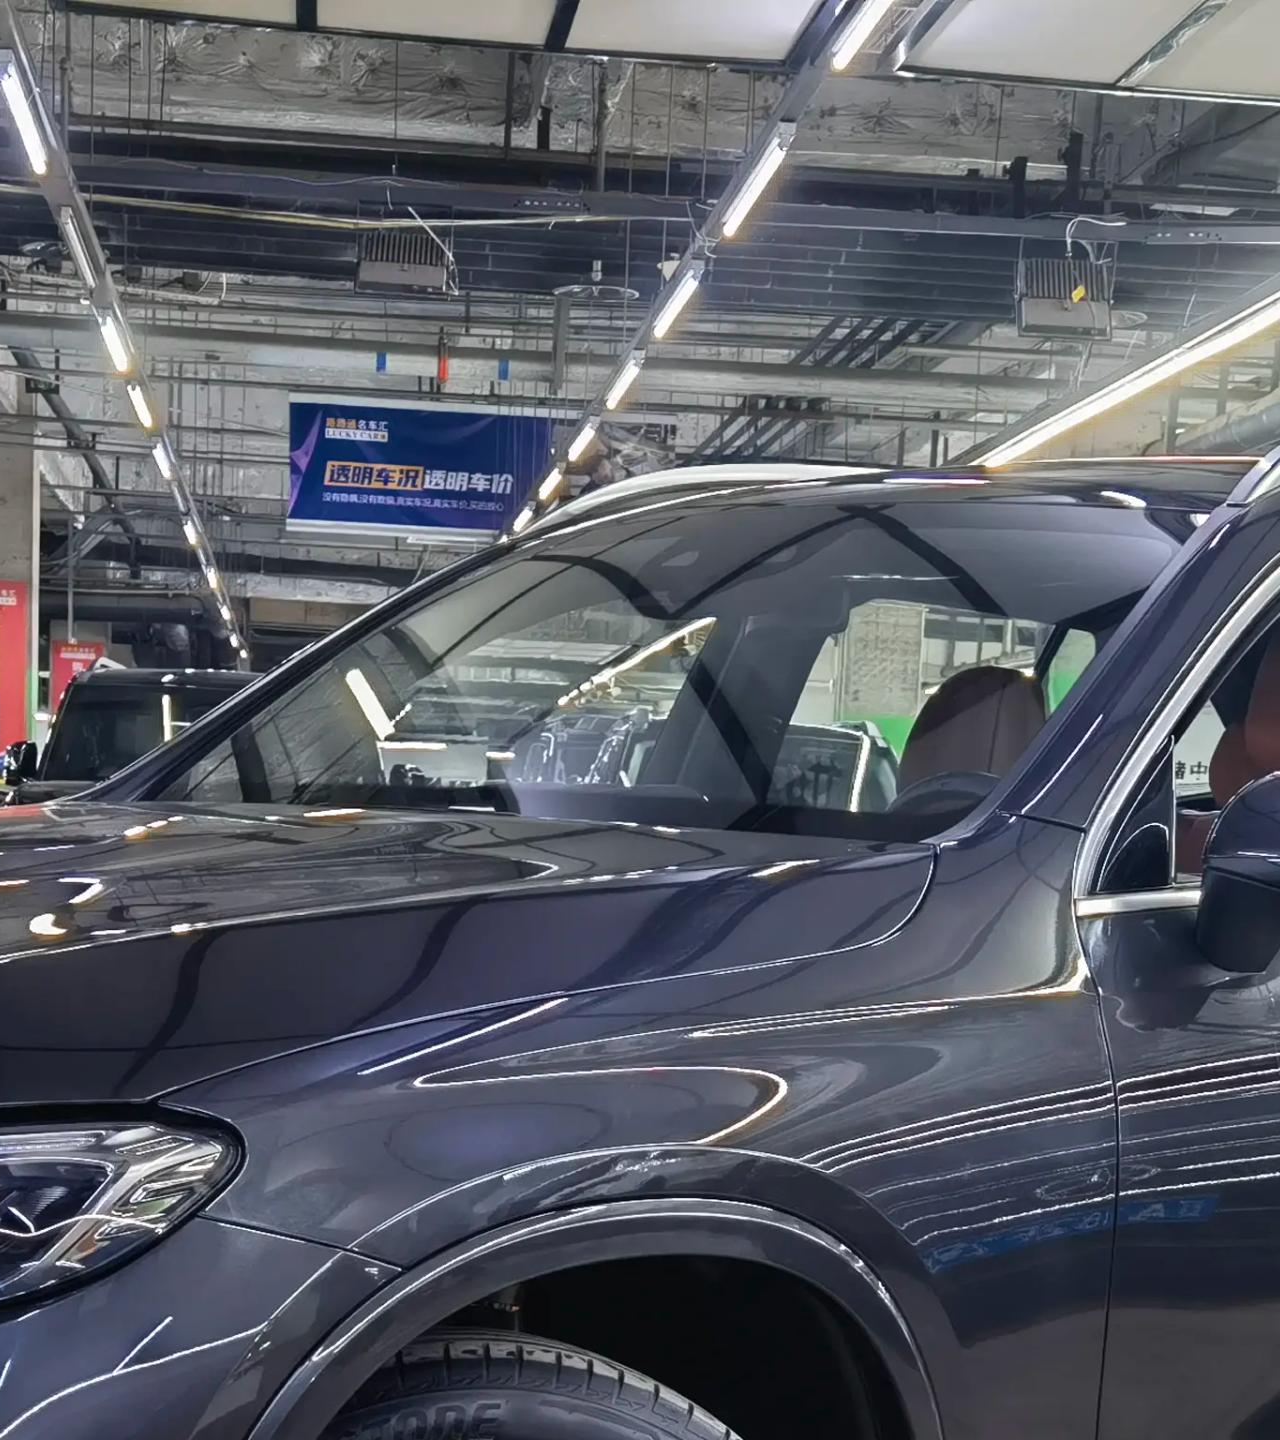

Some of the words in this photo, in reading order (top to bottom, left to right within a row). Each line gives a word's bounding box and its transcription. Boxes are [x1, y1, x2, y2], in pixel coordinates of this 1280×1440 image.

[328, 464, 420, 489] 透明车况
[423, 469, 514, 495] 透明车价
